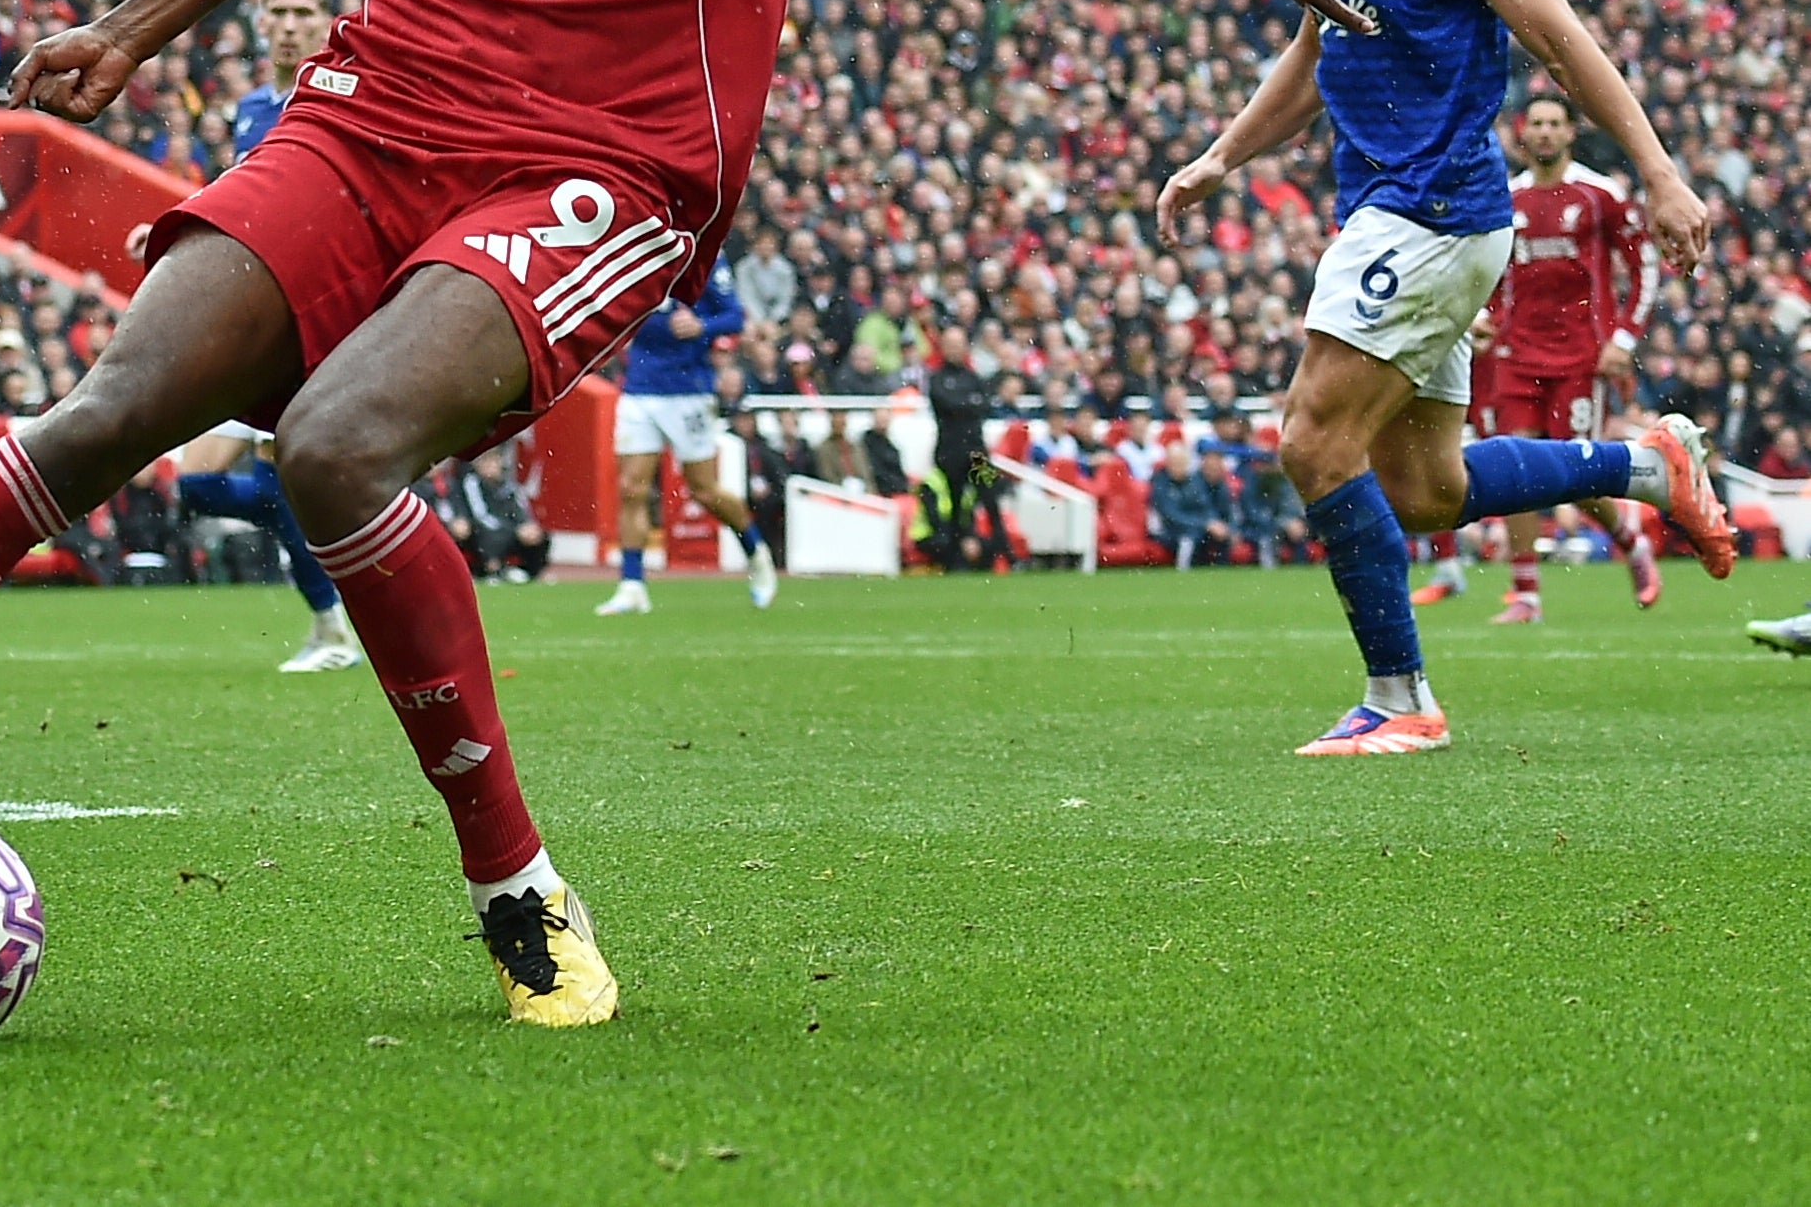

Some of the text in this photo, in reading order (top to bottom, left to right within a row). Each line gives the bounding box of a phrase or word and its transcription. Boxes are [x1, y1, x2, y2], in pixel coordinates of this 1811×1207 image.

[526, 178, 616, 248] 9
[1360, 248, 1399, 301] 6
[390, 681, 459, 710] LFC
